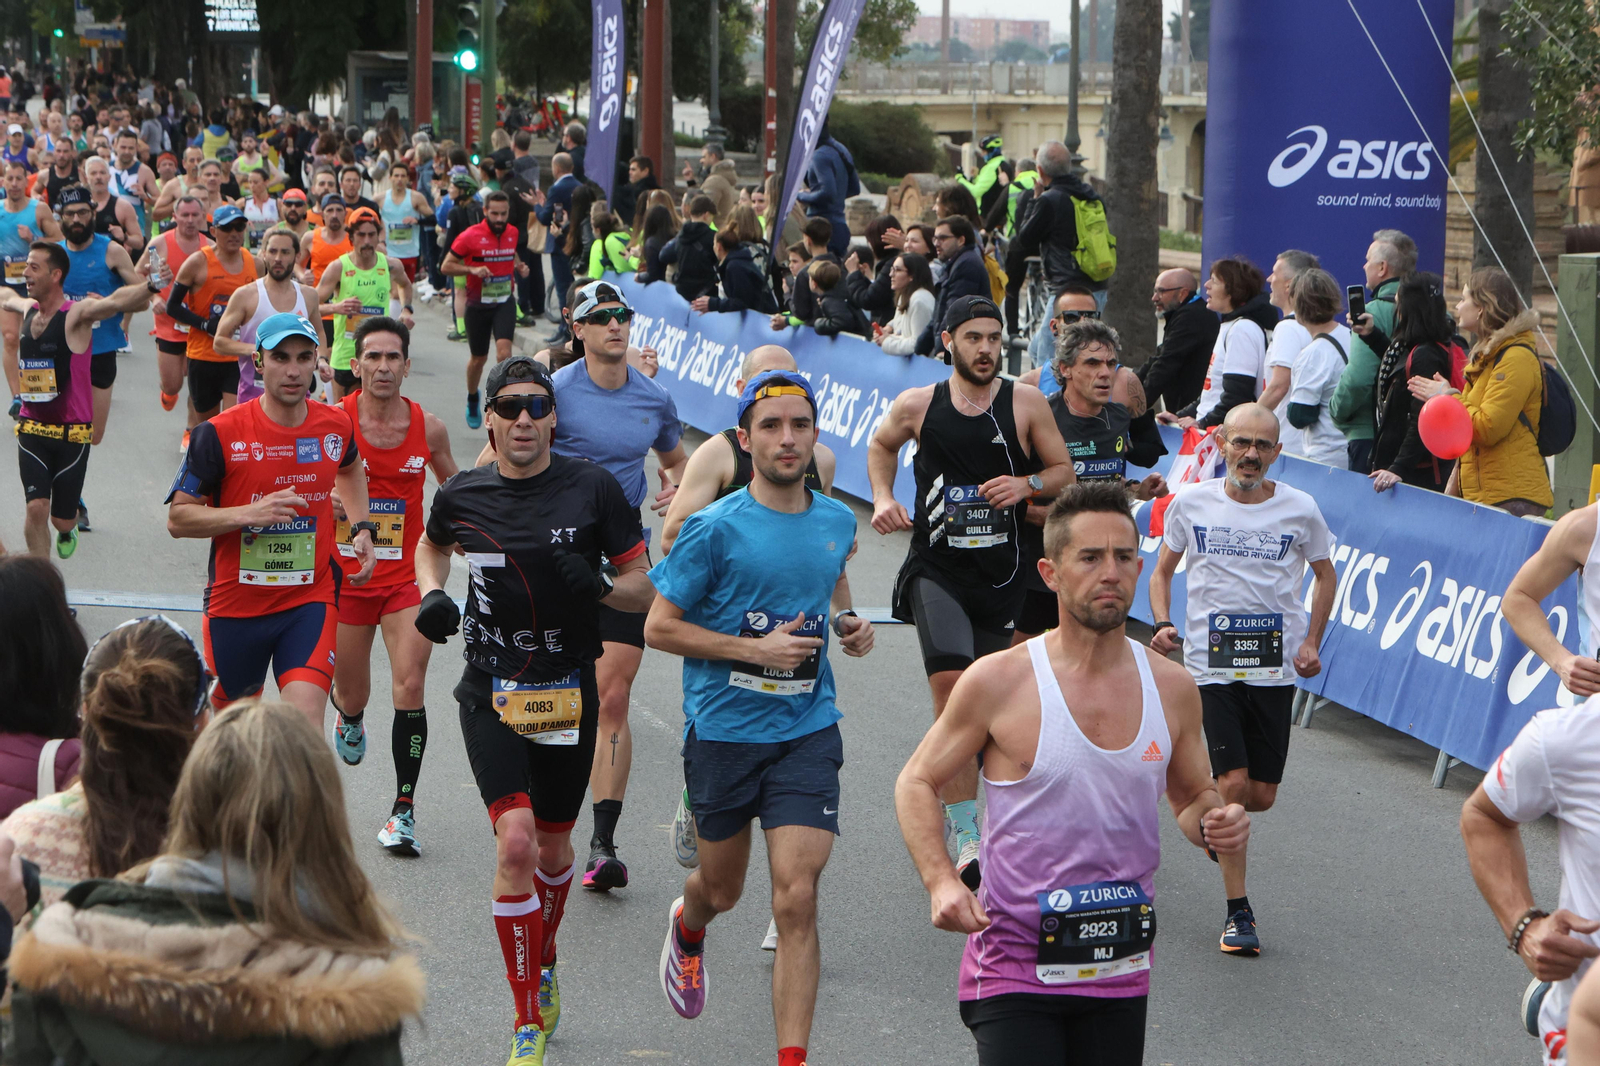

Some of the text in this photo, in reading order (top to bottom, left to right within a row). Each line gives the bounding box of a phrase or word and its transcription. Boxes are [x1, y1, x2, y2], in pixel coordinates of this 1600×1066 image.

[812, 17, 843, 113] asics
[1327, 139, 1432, 180] asics
[1317, 193, 1441, 211] sound mind, sound body
[357, 279, 376, 287] Luis
[819, 382, 861, 438] asics
[1088, 461, 1117, 472] ZURICH
[275, 474, 317, 485] ATLETISMO
[369, 501, 397, 511] URICH
[966, 509, 990, 520] 3407
[966, 526, 992, 534] GUILLE
[267, 543, 292, 554] 1294
[1208, 547, 1277, 560] ANTONIO RIVAS
[264, 559, 294, 570] GÓMEZ
[1234, 618, 1275, 628] ZURICH
[1416, 577, 1503, 680] asics
[1234, 640, 1259, 651] 3352
[1232, 657, 1260, 666] CURRO
[763, 666, 794, 678] LUCAS
[524, 701, 553, 713] 4083
[541, 720, 576, 730] D'AMOR
[1141, 754, 1164, 762] adidas
[1079, 886, 1138, 904] ZURICH
[1079, 921, 1118, 938] 2923
[1094, 947, 1113, 960] MJ
